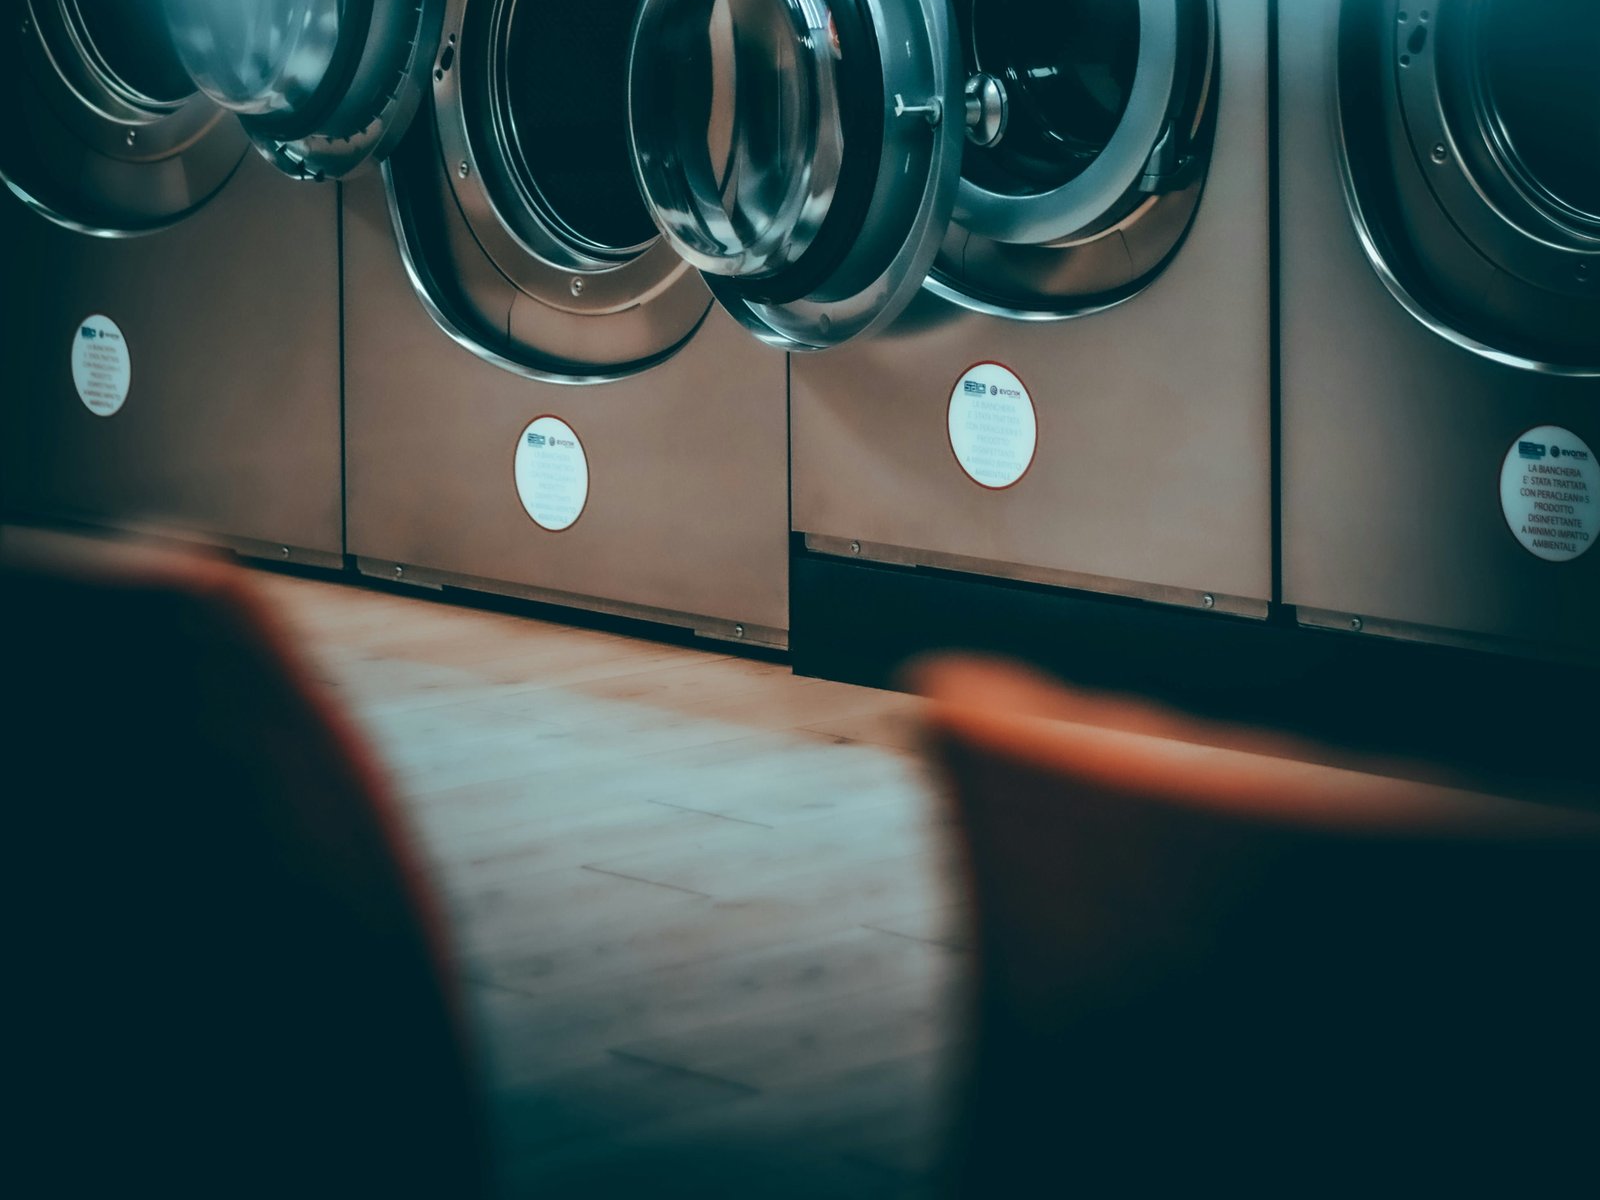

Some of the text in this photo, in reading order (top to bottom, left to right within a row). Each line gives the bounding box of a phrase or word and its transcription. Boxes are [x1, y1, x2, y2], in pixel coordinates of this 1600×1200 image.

[1528, 464, 1581, 478] LA BIANCHERIA
[1531, 476, 1552, 487] STATA
[1553, 479, 1587, 490] TRATTATA
[1520, 488, 1536, 497] CON
[1534, 502, 1574, 514] PRODOTTO
[1528, 513, 1582, 528] DISINFETTANTE
[1521, 525, 1589, 542] A MINIMO IMPATTO
[1532, 538, 1576, 552] AMBIENTALE
